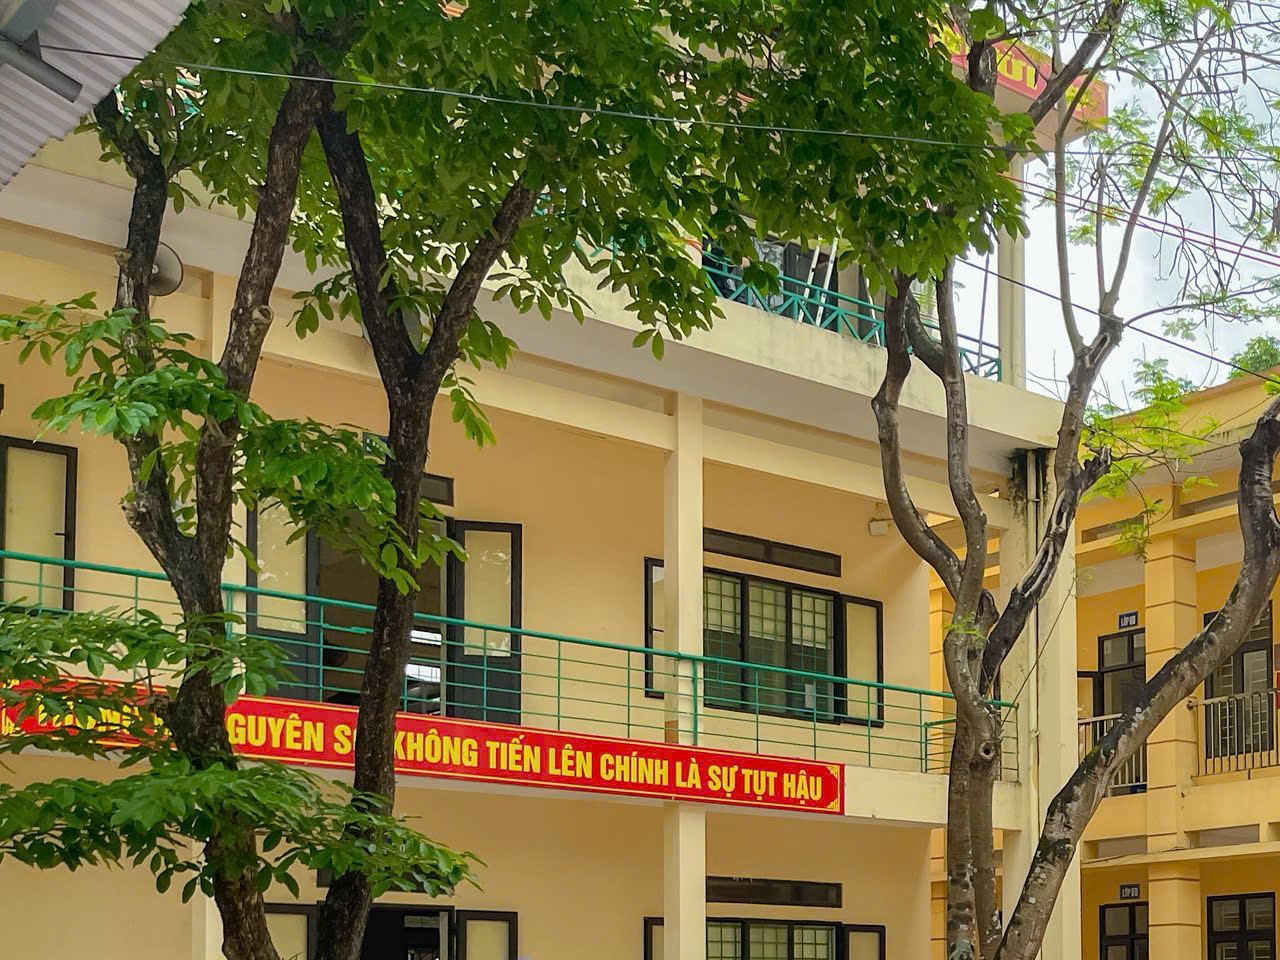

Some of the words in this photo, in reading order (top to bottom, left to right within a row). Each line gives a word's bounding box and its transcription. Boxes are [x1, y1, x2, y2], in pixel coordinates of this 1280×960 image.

[226, 712, 324, 752] GUYÊN
[333, 724, 357, 755] S
[394, 728, 478, 767] KHÔNG
[486, 734, 541, 773] TIẾN
[548, 744, 593, 779] LÊN
[600, 751, 669, 786] CHÍNH
[675, 757, 702, 789] LÀ
[708, 765, 739, 797] SỰ
[742, 768, 777, 800] TỤT
[783, 769, 822, 804] HẬU
